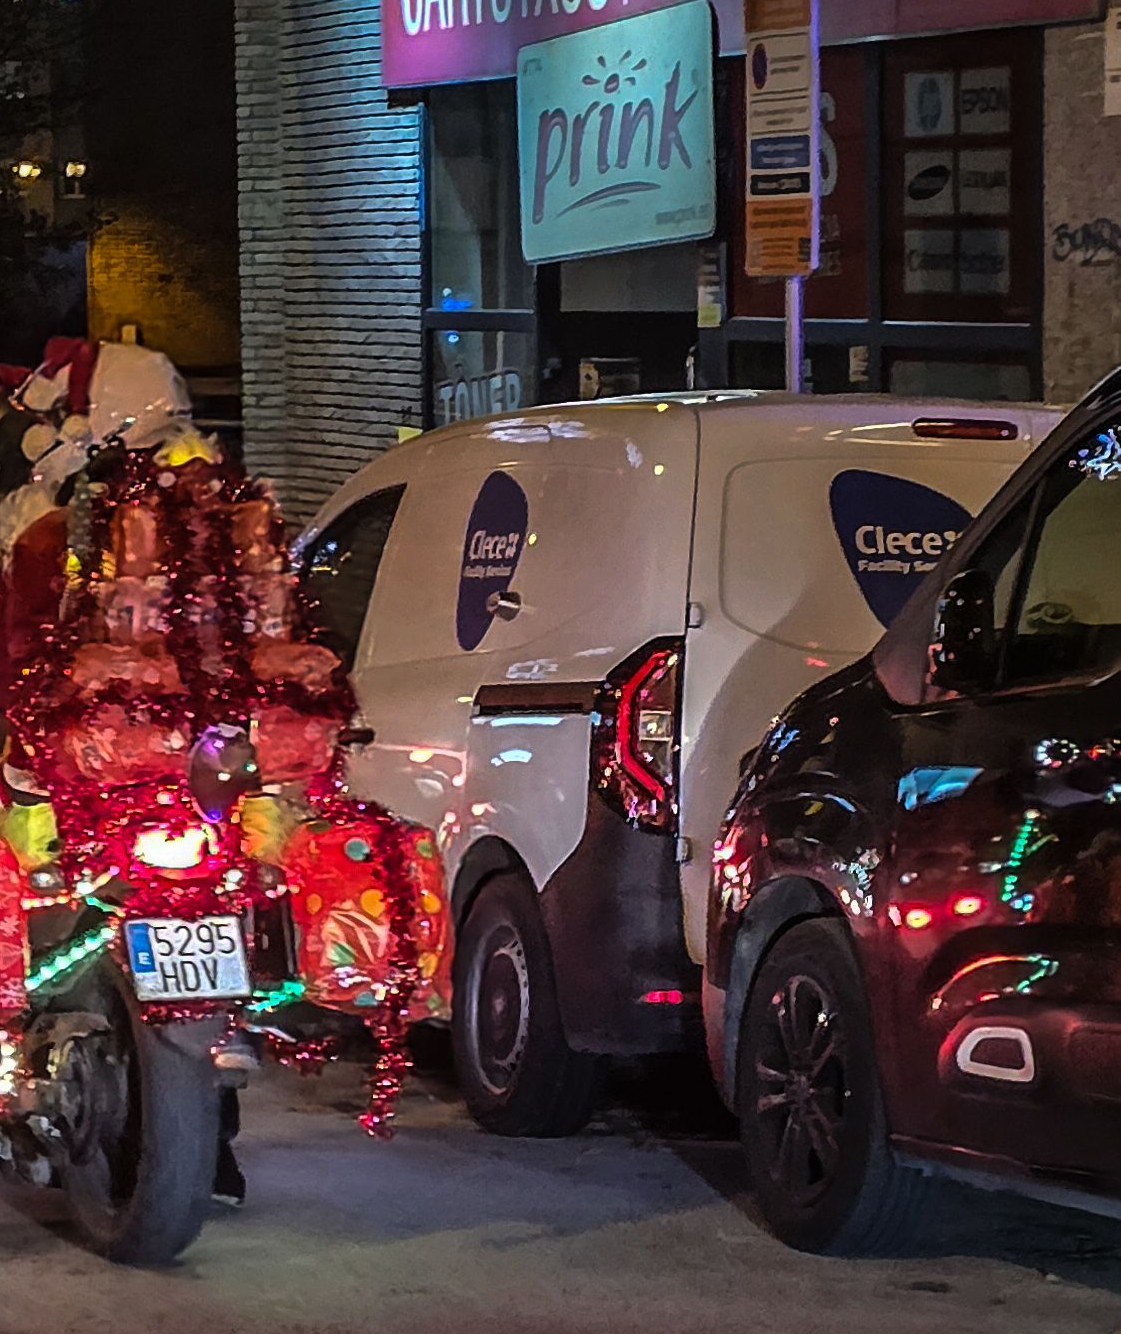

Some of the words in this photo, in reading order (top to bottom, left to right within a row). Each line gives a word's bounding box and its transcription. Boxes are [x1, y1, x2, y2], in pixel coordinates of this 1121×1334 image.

[532, 60, 698, 225] prink
[855, 525, 943, 555] Clece
[153, 922, 236, 957] 5295
[159, 958, 218, 993] HDV
